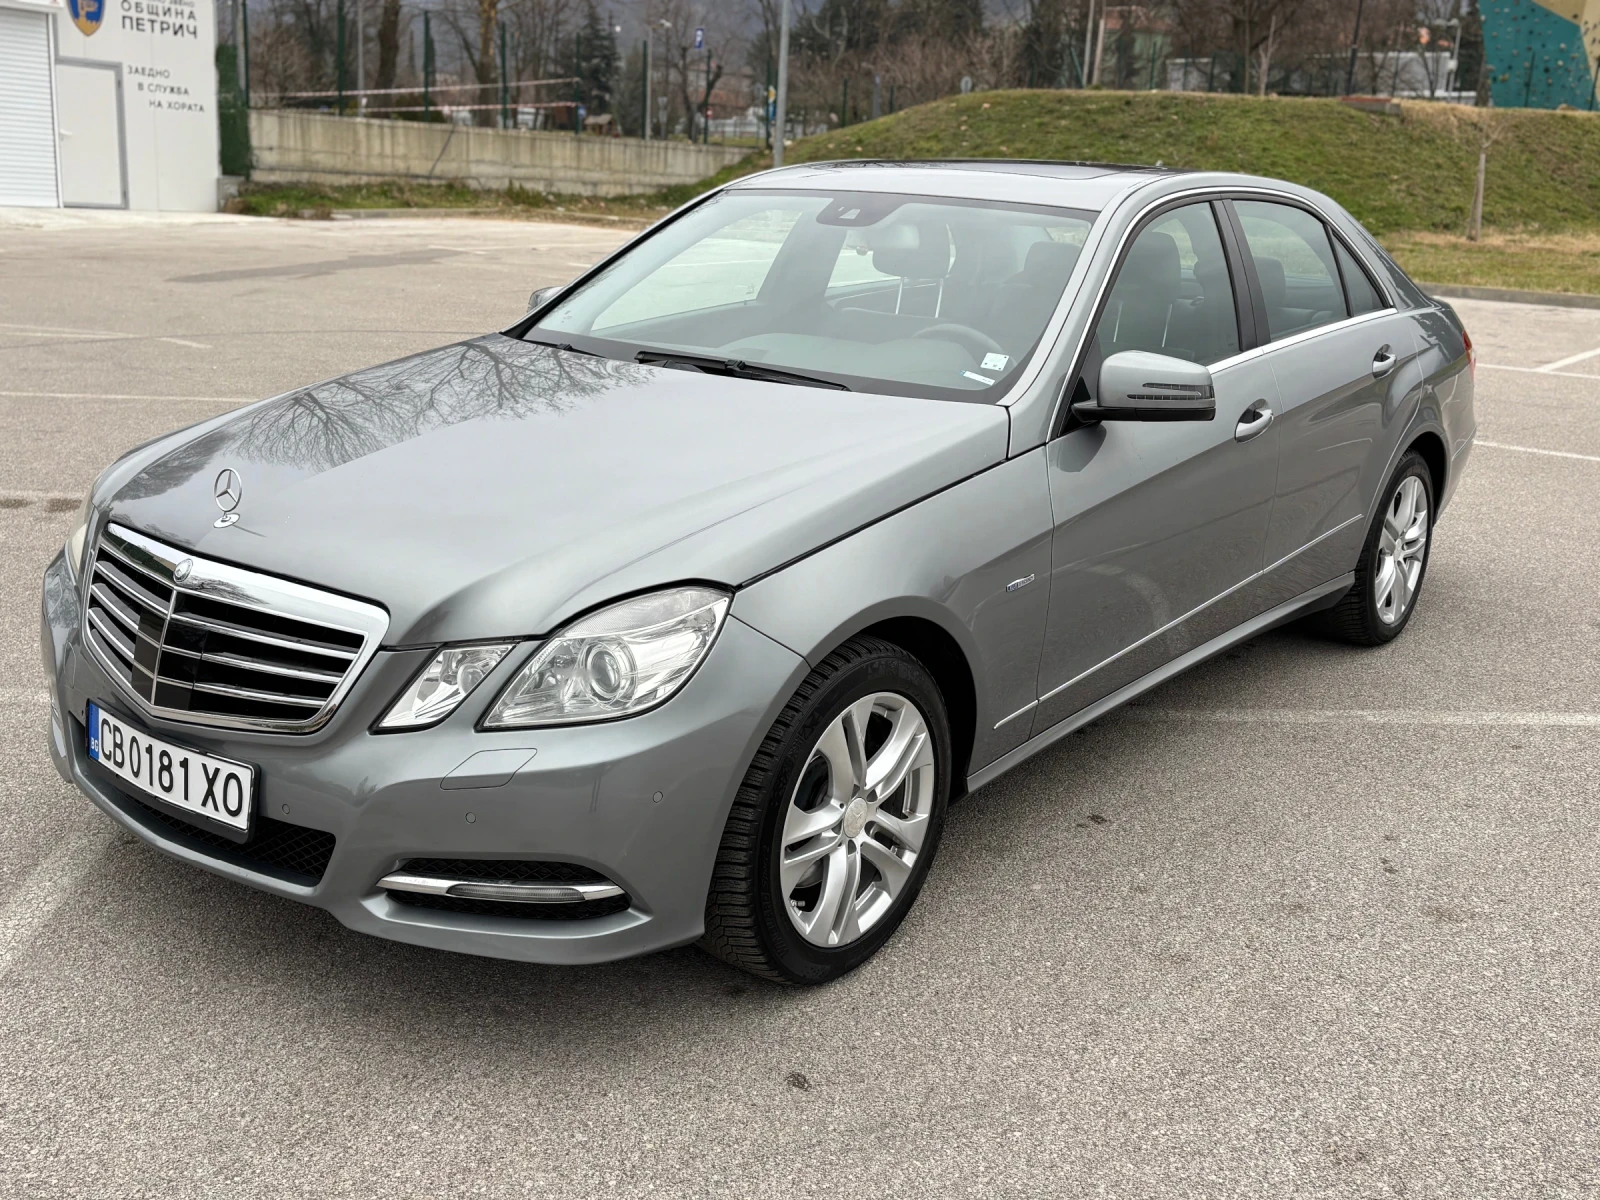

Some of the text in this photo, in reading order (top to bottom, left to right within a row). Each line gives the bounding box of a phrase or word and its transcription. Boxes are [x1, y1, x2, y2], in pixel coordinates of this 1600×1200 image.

[121, 0, 197, 21] ОБЩИНА
[122, 15, 198, 39] ПЕТРИЧ
[127, 64, 171, 79] ЗАЕДНО
[137, 82, 190, 96] В СЛУЖБА
[149, 99, 205, 113] НА ХОРАТА
[91, 736, 99, 752] BG
